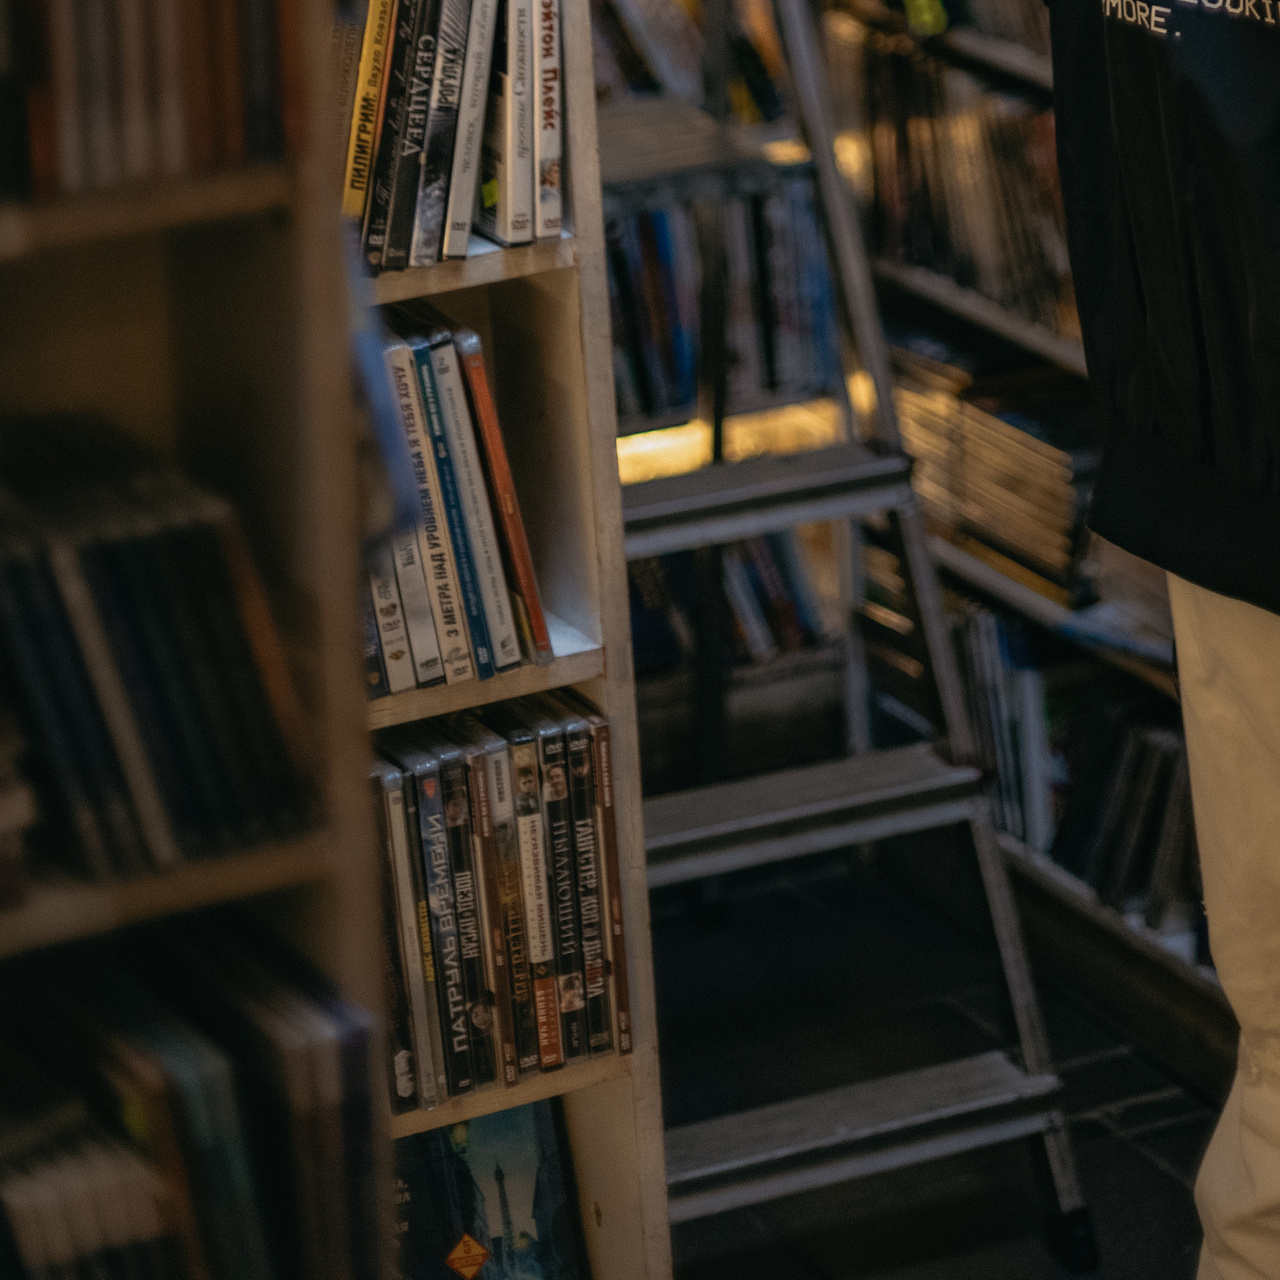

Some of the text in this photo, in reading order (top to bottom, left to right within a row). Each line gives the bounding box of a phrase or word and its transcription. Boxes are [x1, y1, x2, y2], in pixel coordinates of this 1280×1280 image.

[400, 34, 437, 157] СЕРДЦЕЕД
[541, 68, 559, 132] Плейс
[350, 91, 377, 191] ПИЛИГРИМ:
[393, 364, 411, 399] ХОЧУ
[405, 402, 420, 434] ТЕБЯ
[413, 451, 429, 484] НЕБА
[433, 553, 450, 580] НАД
[439, 584, 457, 625] МЕТРА
[446, 626, 459, 638] 3
[454, 871, 474, 912] ПОЕЗД
[530, 819, 549, 958] НЕУЯЗВИМАЯ МИШЕНЬ
[552, 820, 575, 956] ПЫЛАЮЩИЙ
[581, 895, 600, 924] КОП
[423, 814, 468, 1053] ПАТРУЛЬ ВРЕМЕНИ
[459, 918, 480, 958] ПУСАН
[424, 950, 436, 982] АДРЕС
